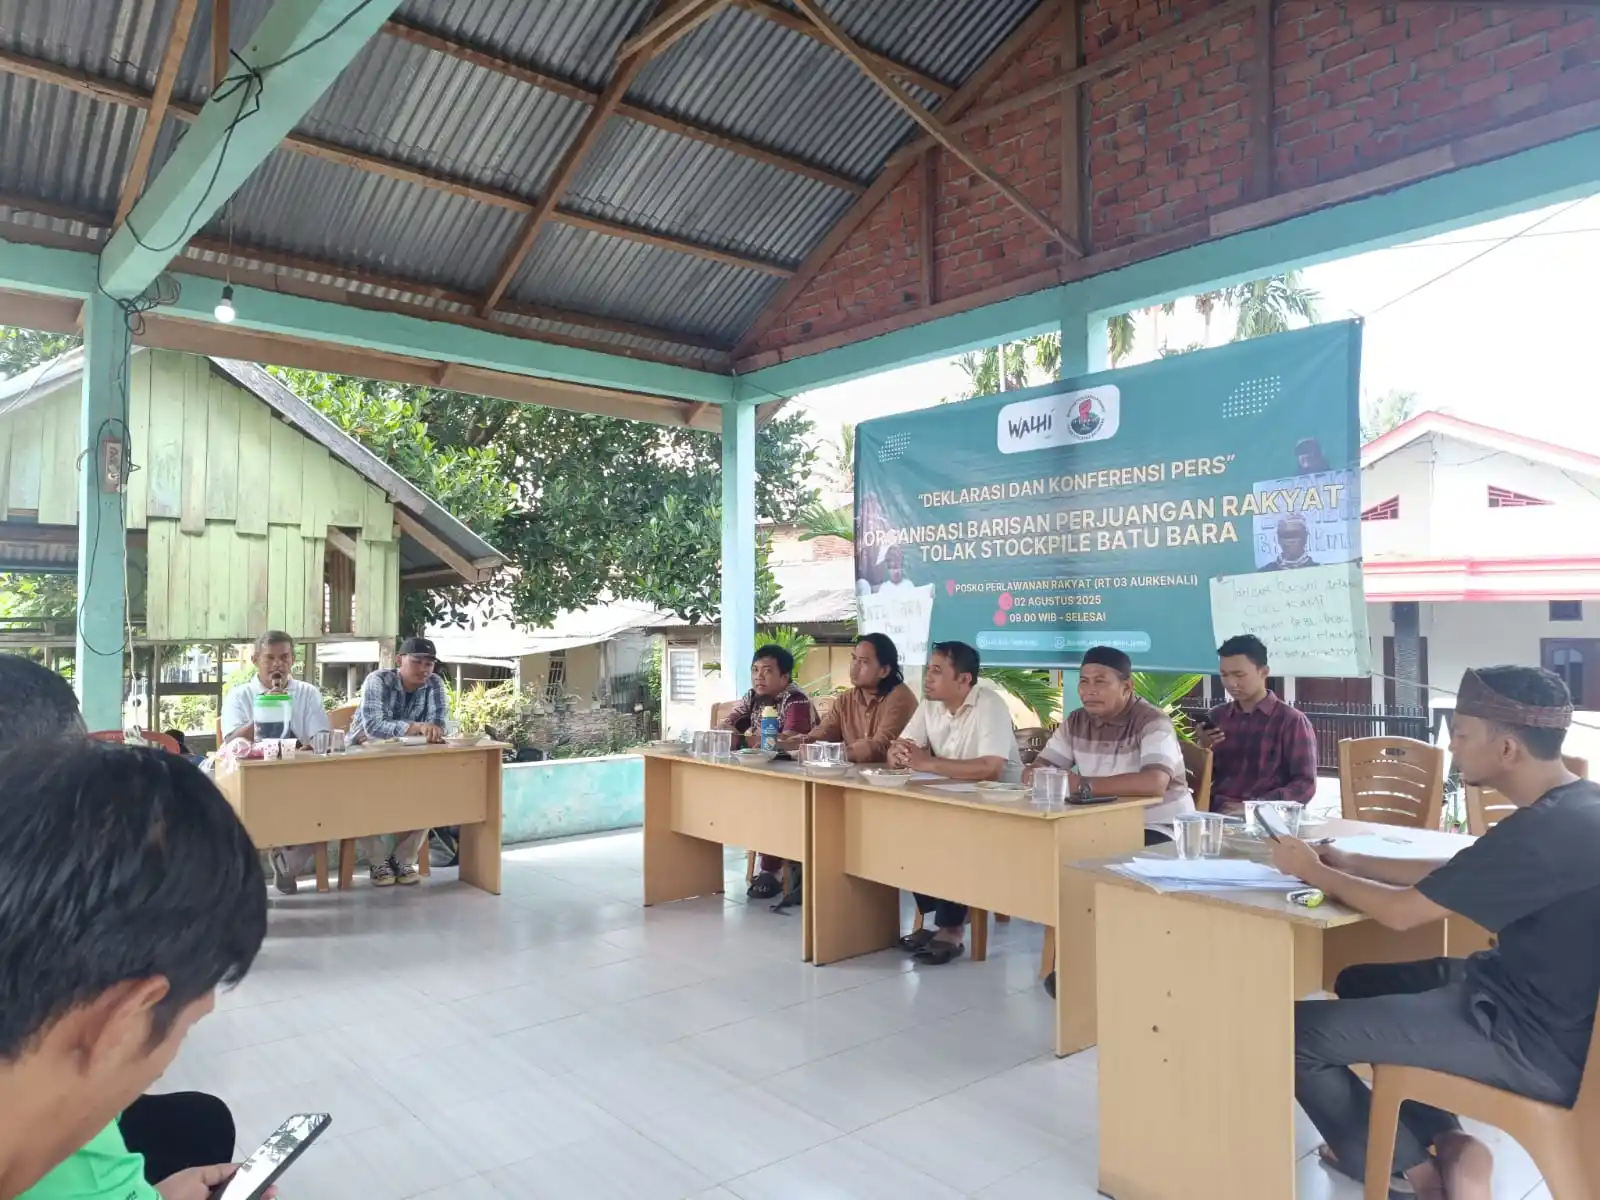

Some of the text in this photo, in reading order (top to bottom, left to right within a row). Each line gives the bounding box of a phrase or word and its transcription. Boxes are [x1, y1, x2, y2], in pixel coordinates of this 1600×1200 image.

[1009, 479, 1044, 498] DAN
[1049, 463, 1165, 493] KONFERENSI
[864, 484, 1345, 547] ORGANISASI BARISAN PERJUANGAN RAKYAT
[920, 544, 976, 562] TOLAK
[980, 533, 1091, 559] STOCKPILE
[1097, 526, 1160, 551] BATU
[1166, 521, 1238, 547] BARA
[955, 574, 1198, 593] POSKO PERLAWANAN RAKYAT (RT 03 AURKENALI)
[1014, 595, 1102, 607] 02 AGUSTUS 2025
[1009, 613, 1037, 623] 09.00
[1038, 612, 1057, 622] WIB
[1065, 612, 1106, 623] SELESAI
